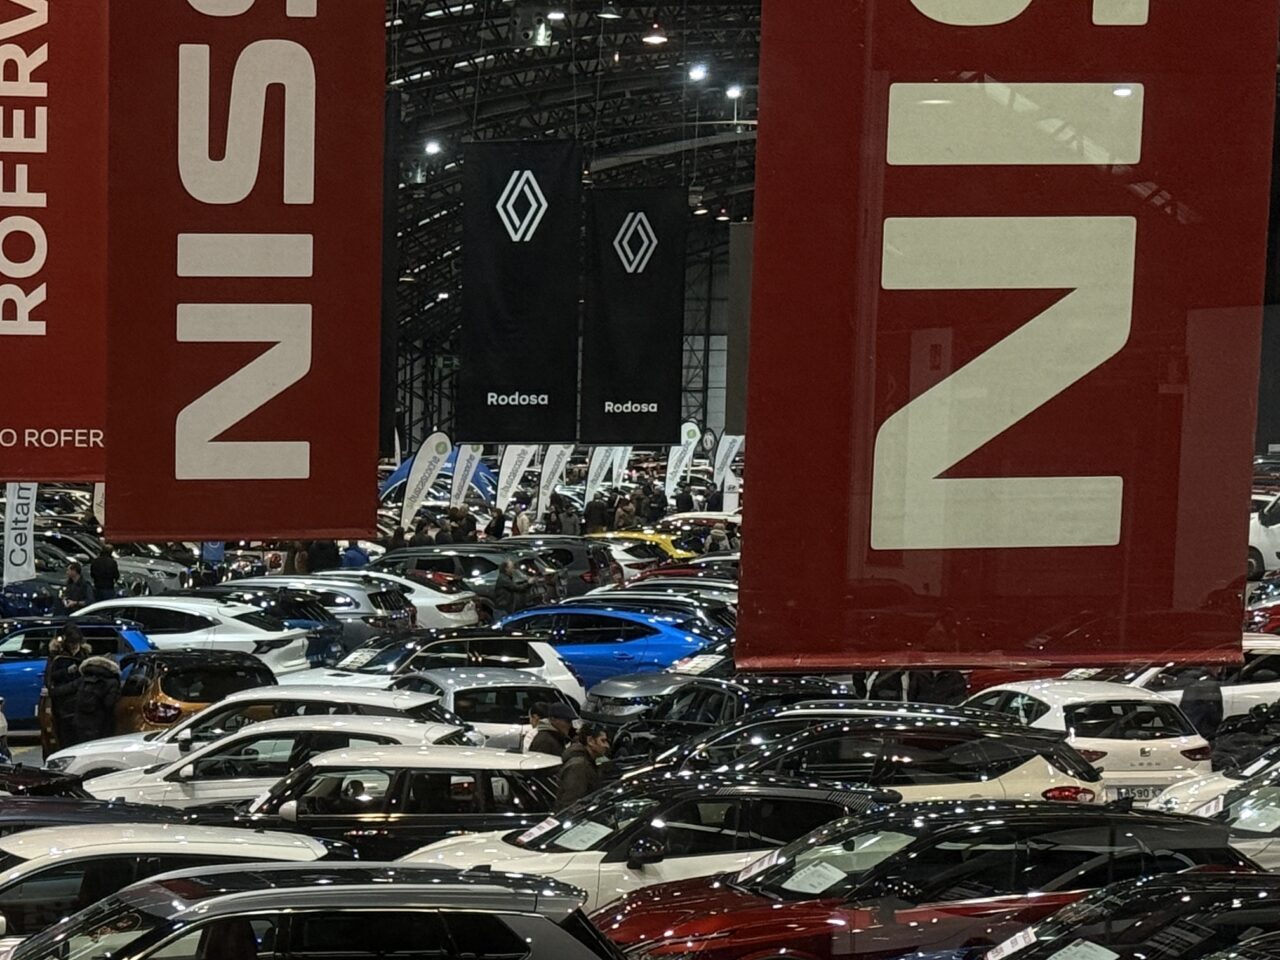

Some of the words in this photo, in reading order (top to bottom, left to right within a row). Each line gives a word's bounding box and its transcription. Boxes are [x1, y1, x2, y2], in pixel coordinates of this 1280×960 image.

[871, 0, 1150, 550] NI
[487, 392, 549, 406] Rodosa
[604, 401, 658, 414] Rodosa
